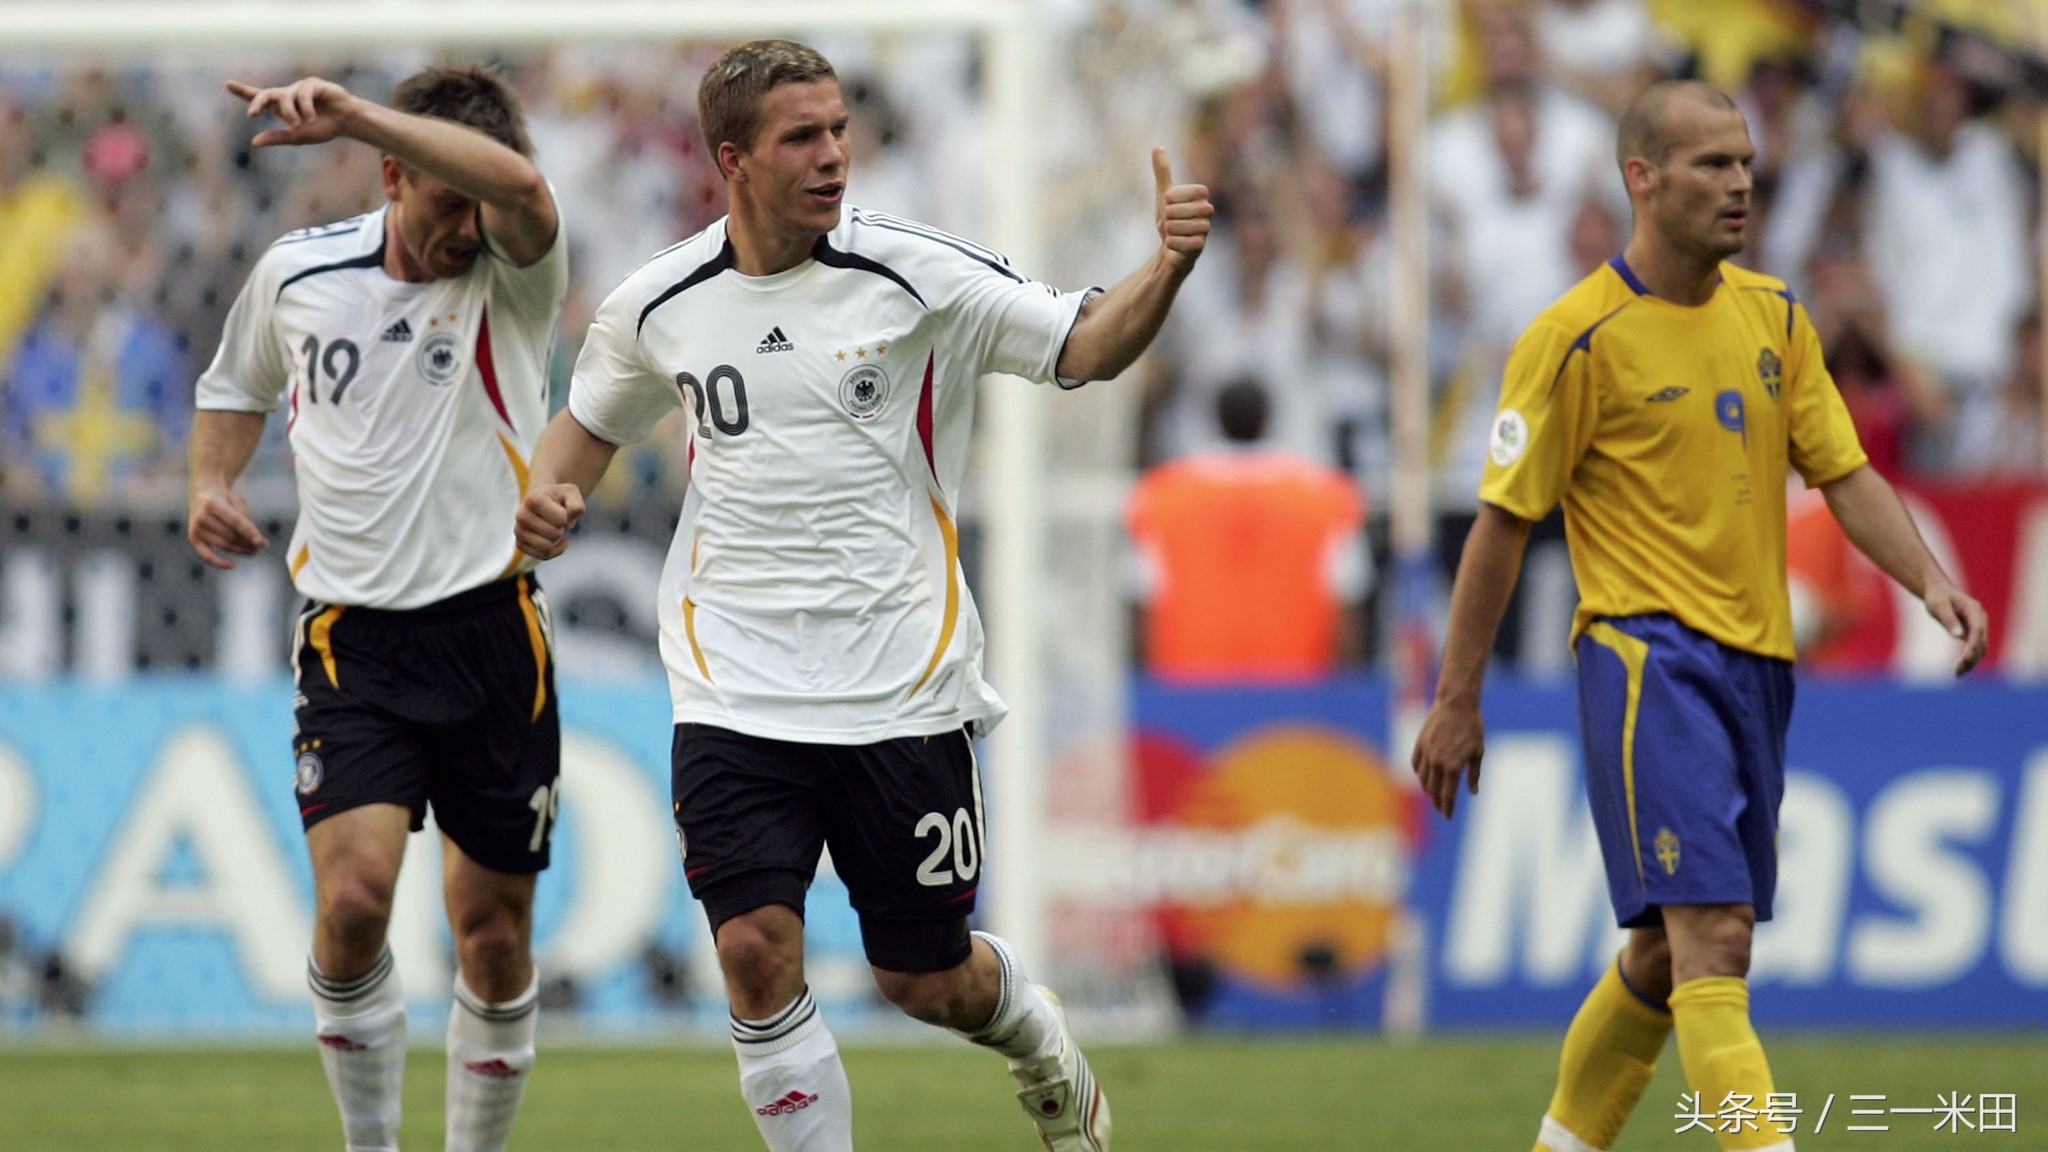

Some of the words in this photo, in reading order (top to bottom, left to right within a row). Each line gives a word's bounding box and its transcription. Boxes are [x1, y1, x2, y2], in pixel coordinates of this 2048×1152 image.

[301, 334, 360, 406] 19
[756, 341, 794, 354] adidas
[676, 364, 749, 439] 20
[1714, 388, 1747, 452] 9
[914, 807, 978, 886] 20
